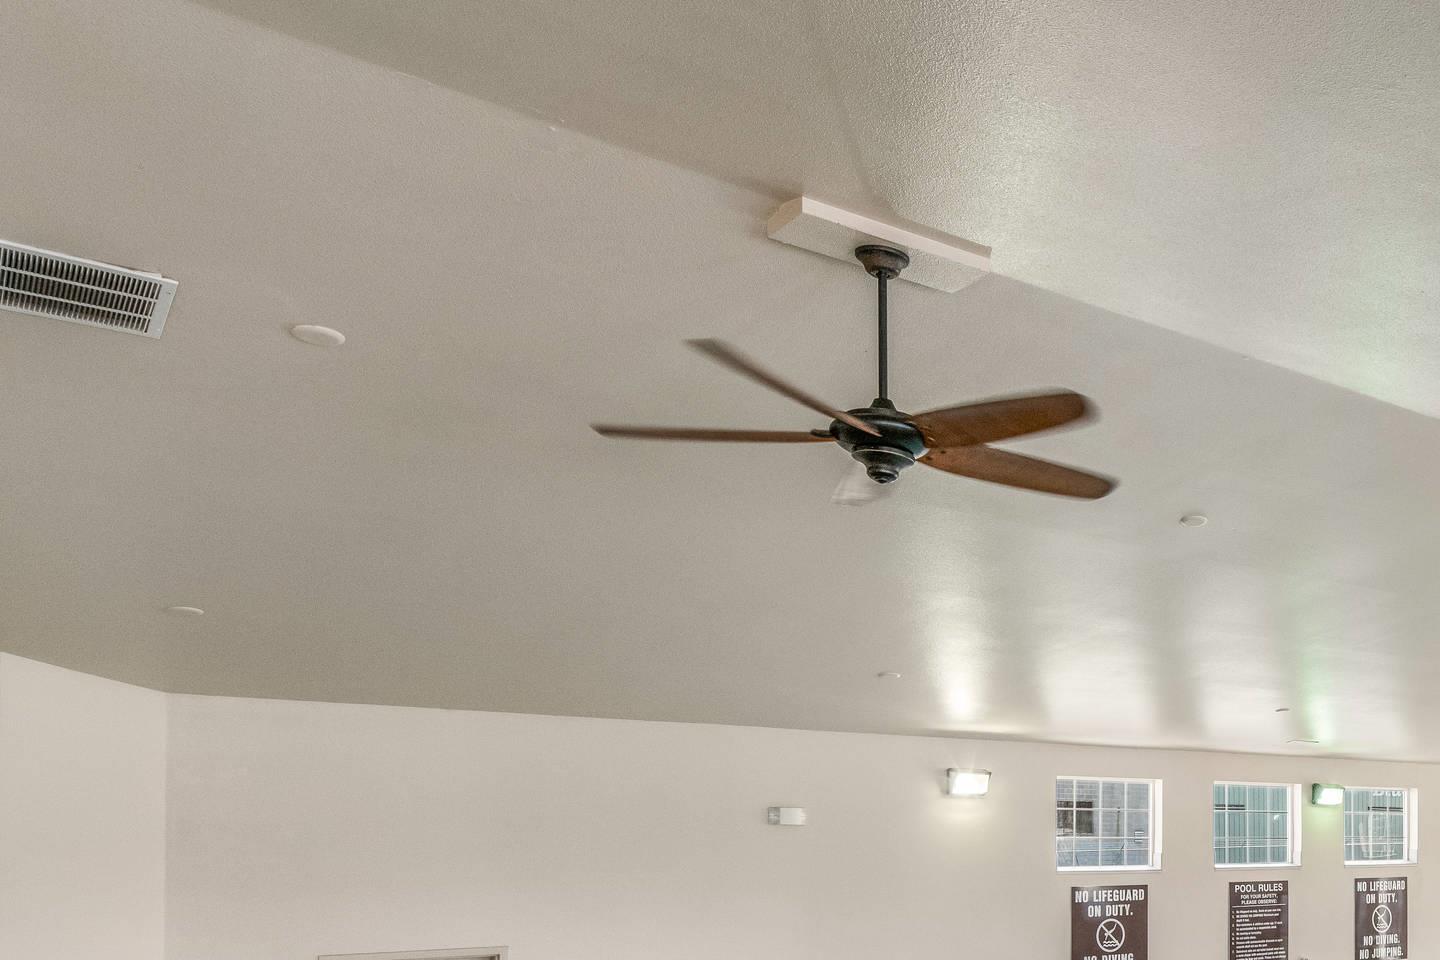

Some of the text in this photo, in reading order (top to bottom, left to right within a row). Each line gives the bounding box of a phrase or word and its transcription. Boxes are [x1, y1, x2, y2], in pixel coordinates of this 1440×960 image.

[1234, 883, 1284, 893] POOL RULES
[1357, 880, 1406, 892] NO LIFEGUARD
[1075, 889, 1145, 903] NO LIFEGUARD
[1366, 893, 1398, 904] ON DUTY.
[1087, 904, 1133, 918] ON DUTY.
[1363, 934, 1401, 946] NO DIVING.
[1359, 946, 1404, 960] NO JUMPING.
